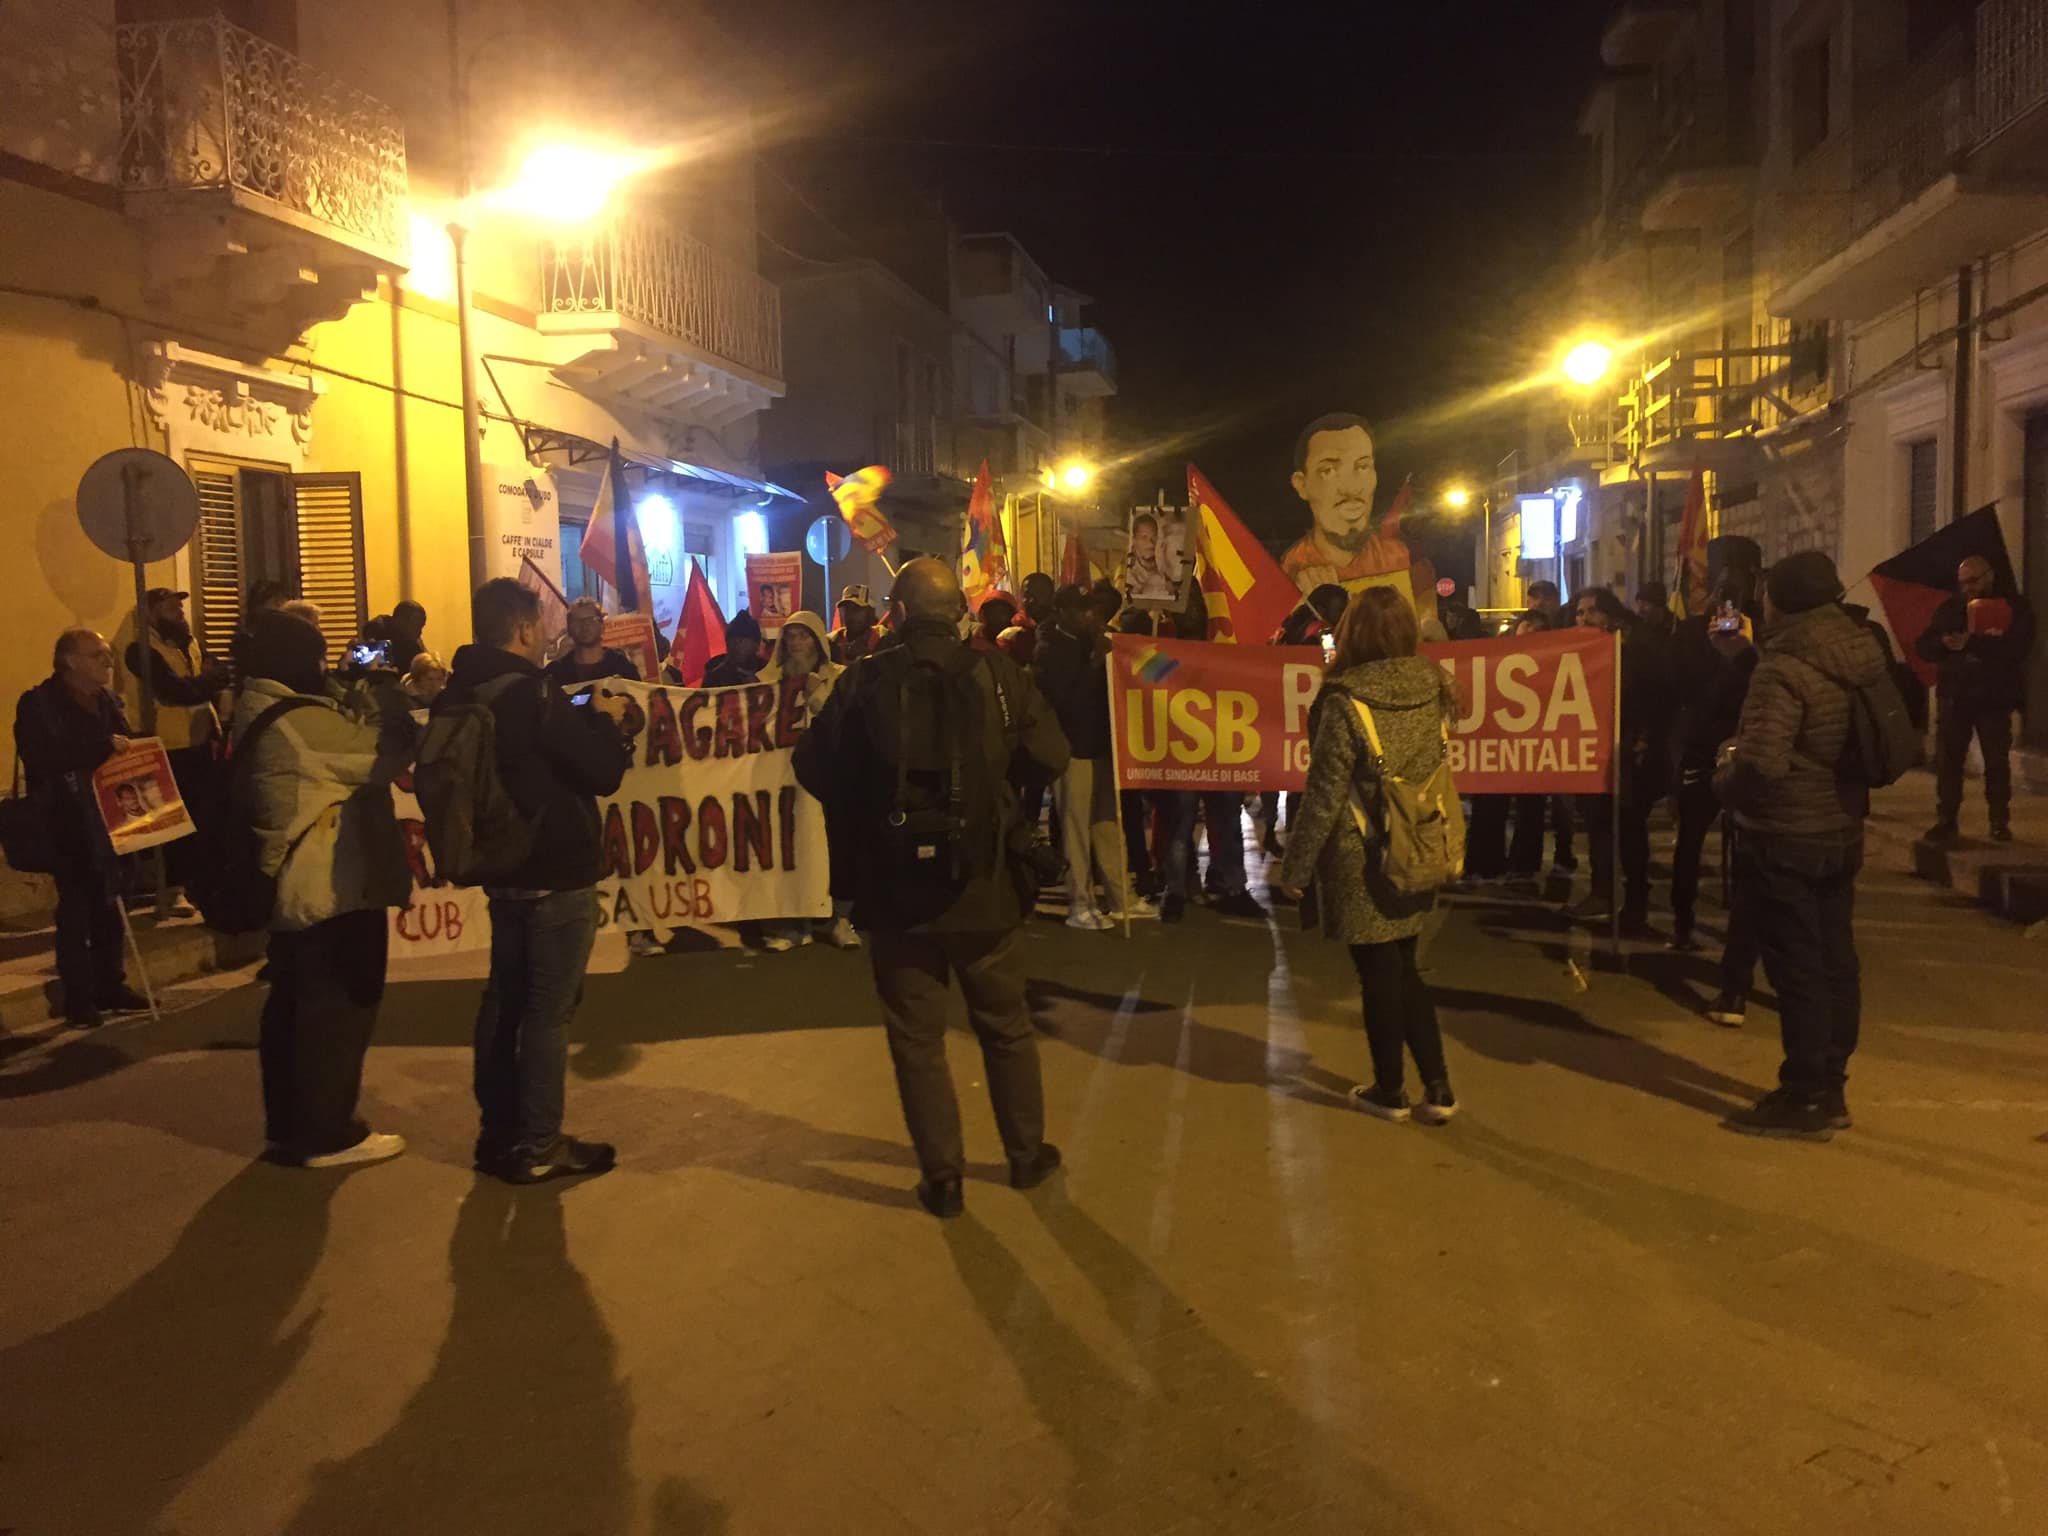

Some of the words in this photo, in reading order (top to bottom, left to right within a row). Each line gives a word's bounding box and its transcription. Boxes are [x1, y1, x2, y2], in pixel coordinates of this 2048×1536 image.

[512, 546, 517, 557] E
[518, 547, 545, 559] CAPSULE
[524, 535, 531, 546] IN
[532, 536, 552, 548] CIALDE
[1282, 652, 1598, 735] RUSA
[1126, 688, 1261, 764] USB
[1127, 767, 1163, 780] UNIONE
[1164, 768, 1219, 782] SINDACALE
[1220, 770, 1231, 782] DI
[1233, 770, 1261, 783] BASE
[1448, 737, 1599, 772] BIENTALE
[602, 785, 797, 879] ADRONI
[649, 878, 714, 919] USB
[396, 901, 463, 942] CUB
